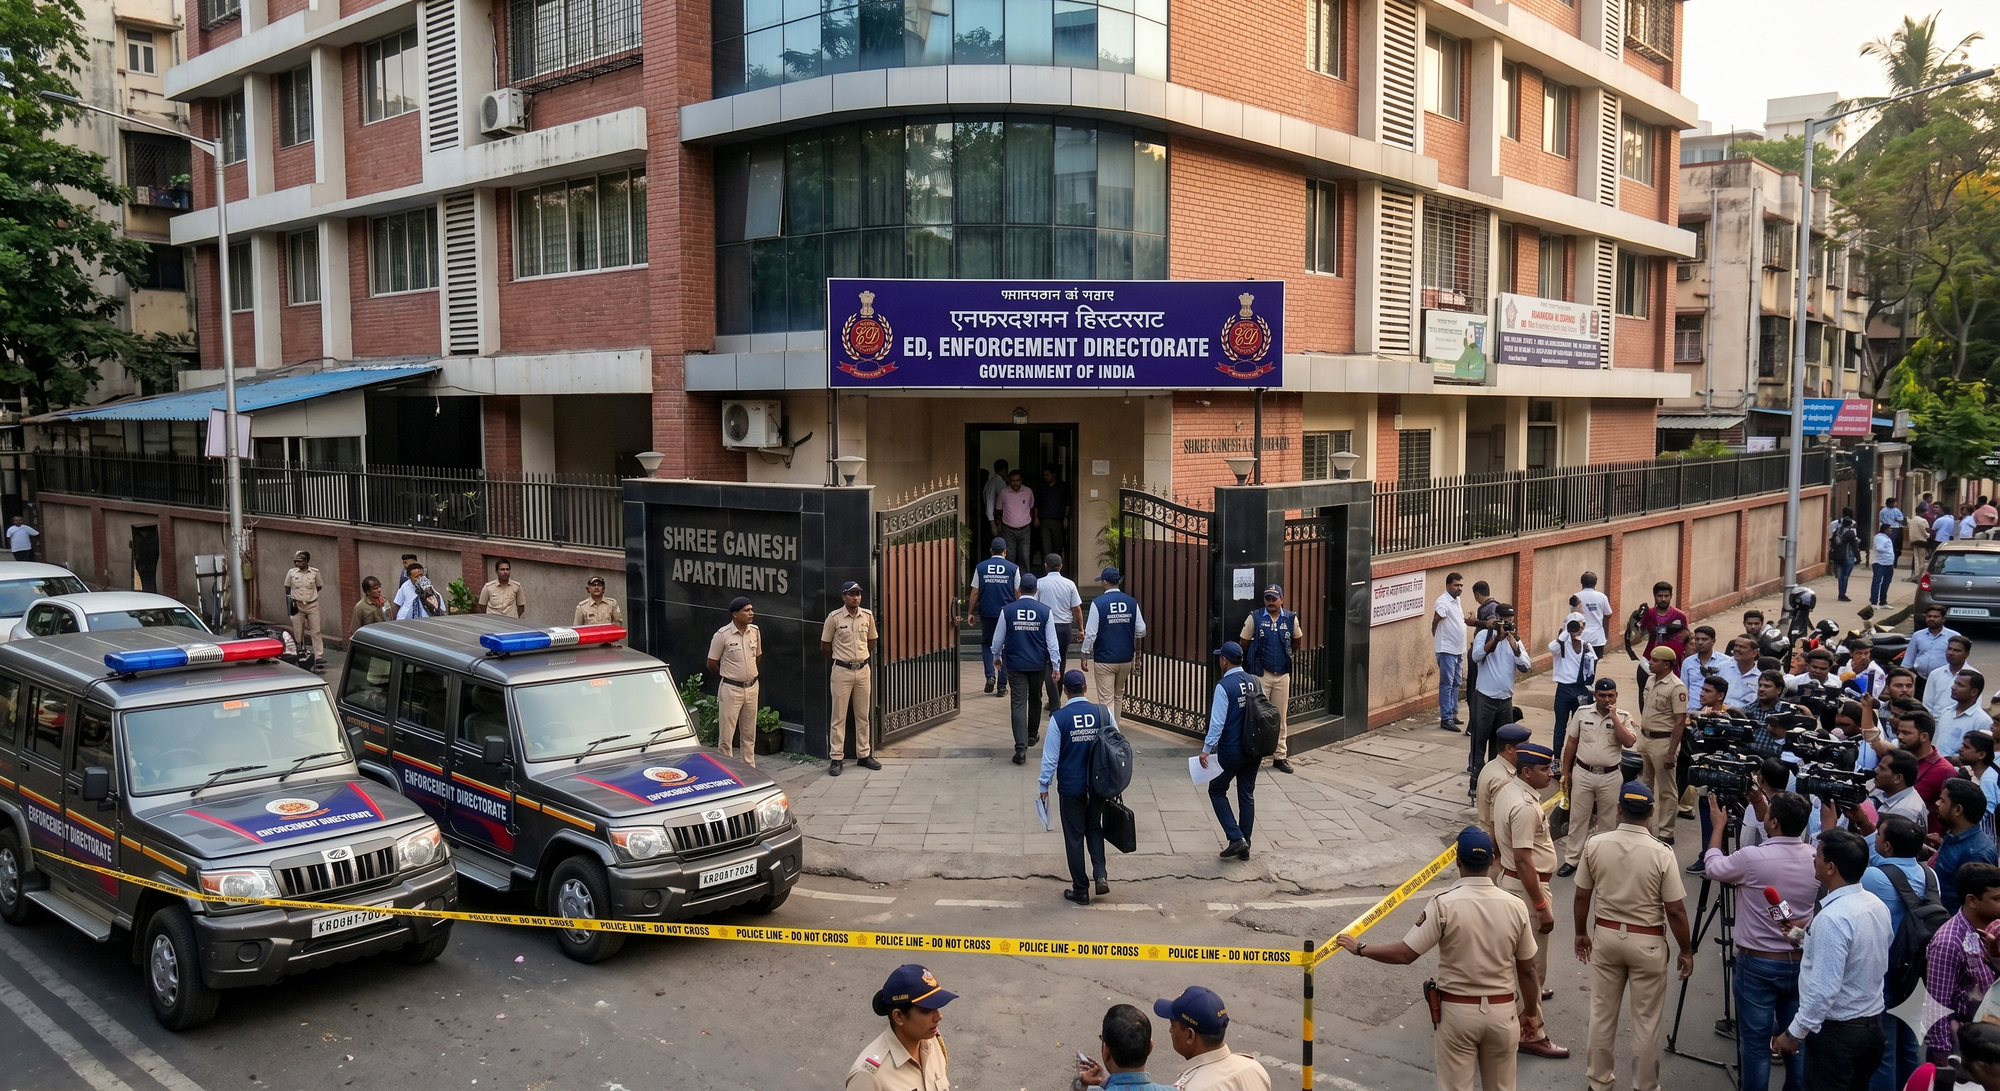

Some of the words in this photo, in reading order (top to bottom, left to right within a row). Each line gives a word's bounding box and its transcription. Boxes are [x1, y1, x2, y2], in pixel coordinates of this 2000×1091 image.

[949, 311, 1069, 331] एनफरदशमन
[903, 336, 933, 361] ED,
[939, 336, 1078, 357] ENFORCEMENT
[1083, 337, 1210, 358] DIRECTORATE
[979, 364, 1073, 379] GOVERNMENT
[1076, 364, 1094, 379] OF
[1098, 364, 1136, 379] INDIA
[663, 526, 717, 554] SHREE
[722, 530, 797, 561] GANESH
[671, 558, 788, 594] APARTMENTS
[987, 564, 1006, 574] ED
[1016, 609, 1037, 621] ED
[1110, 602, 1127, 613] ED
[1073, 714, 1095, 728] ED
[404, 768, 455, 802] ENFORCEMENT
[456, 788, 507, 821] DIRECTORATE
[70, 826, 112, 863] DIRECTORATE
[468, 914, 495, 922] POLICE
[496, 915, 513, 923] LINE
[600, 921, 628, 931] POLICE
[629, 923, 647, 932] LINE
[654, 924, 665, 933] DO
[667, 925, 682, 934] NOT
[684, 926, 710, 936] CROSS
[736, 928, 764, 939] POLICE
[766, 930, 783, 940] LINE
[791, 931, 802, 941] DO
[804, 932, 820, 942] NOT
[822, 932, 849, 943] CROSS
[875, 935, 904, 946] POLICE
[906, 936, 924, 947] LINE
[932, 937, 943, 948] DO
[945, 938, 962, 949] NOT
[963, 939, 991, 950] CROSS
[1019, 942, 1049, 952] POLICE
[1051, 943, 1069, 954] LINE
[1078, 944, 1089, 954] DO
[1092, 945, 1109, 955] NOT
[1111, 945, 1139, 957] CROSS
[1168, 948, 1199, 959] POLICE
[1201, 949, 1220, 960] LINE
[1229, 950, 1241, 960] DO
[1243, 950, 1260, 961] NOT
[1262, 951, 1290, 962] CROSS
